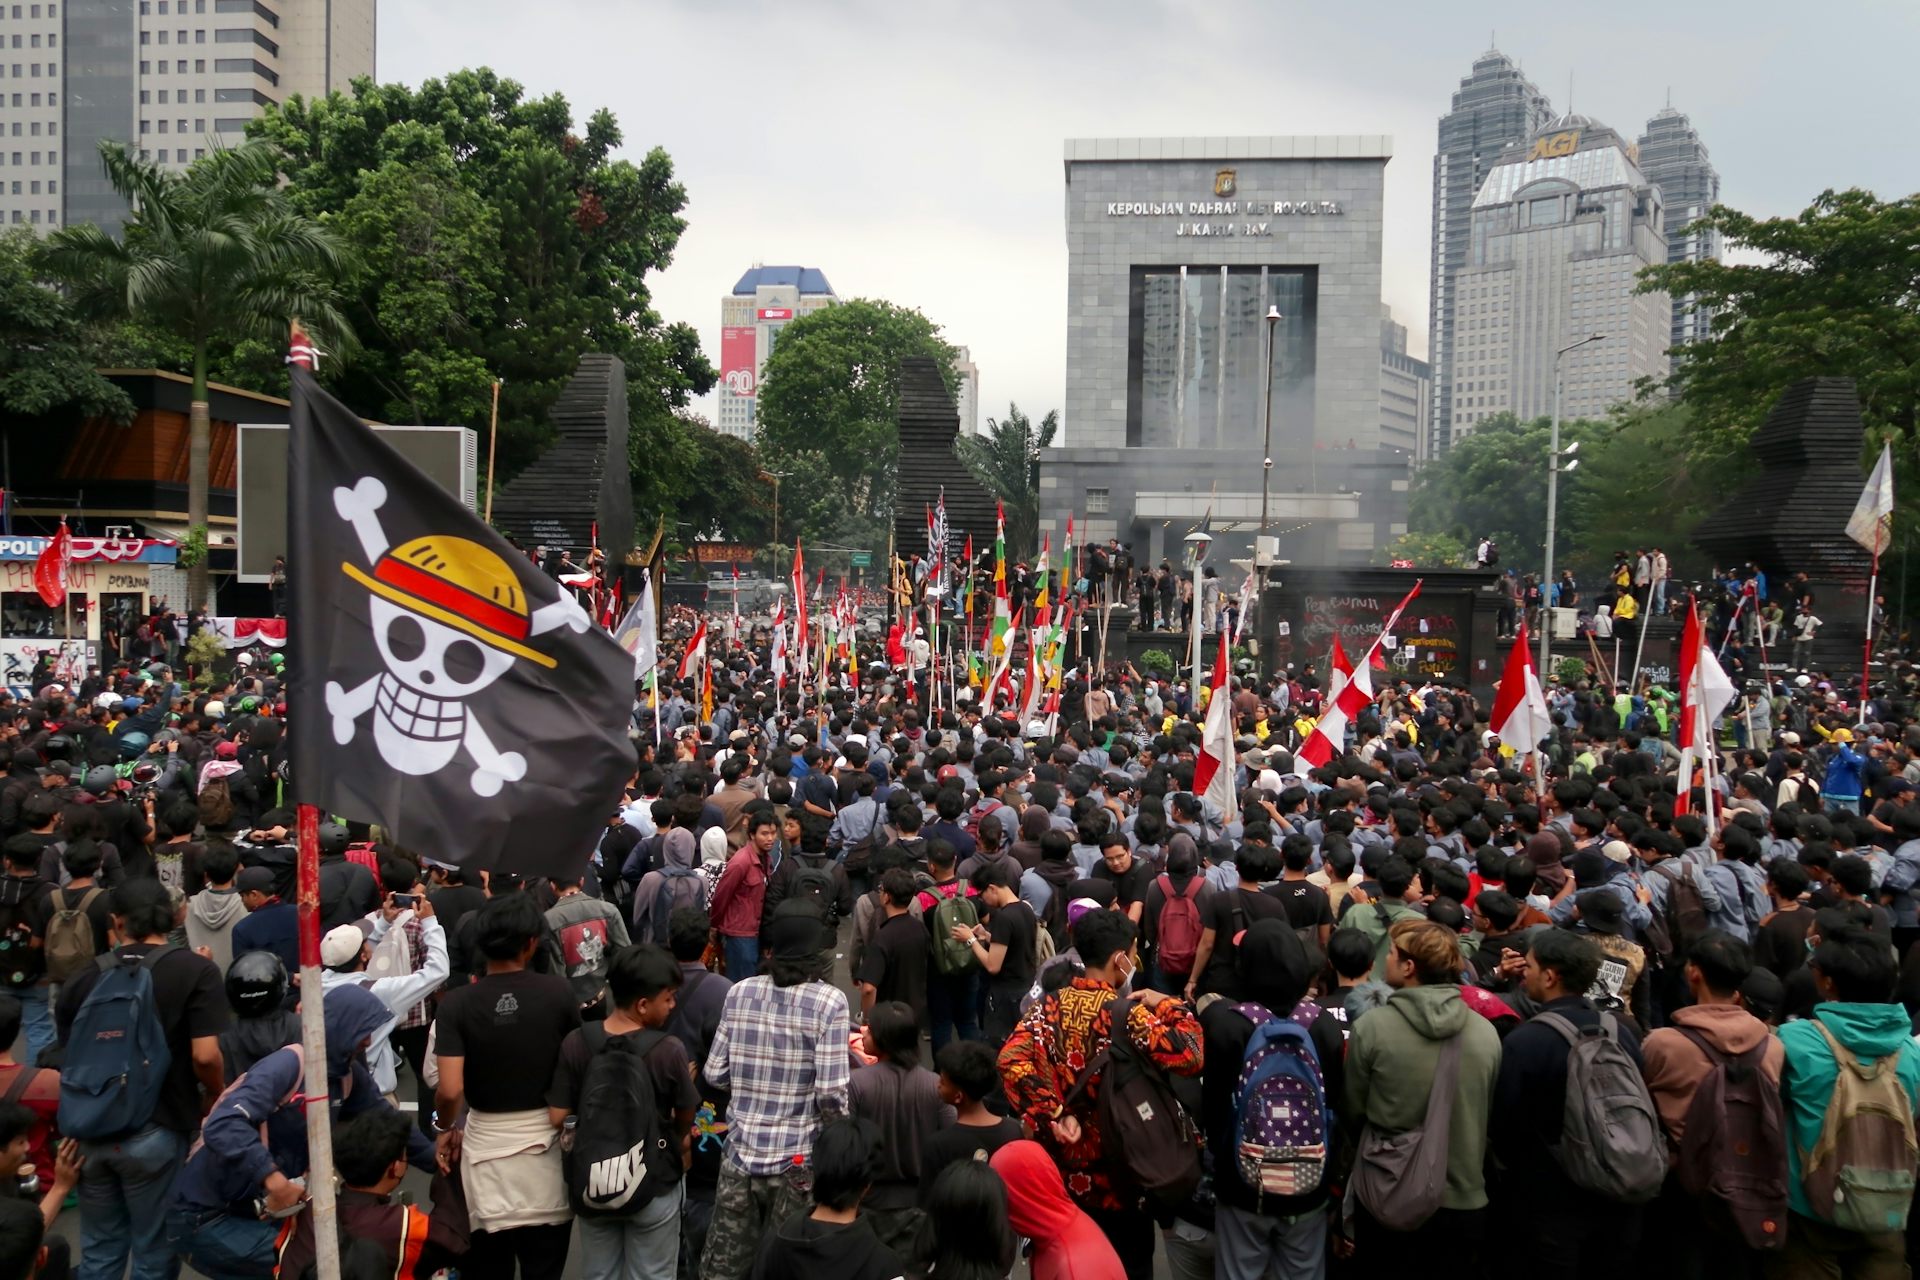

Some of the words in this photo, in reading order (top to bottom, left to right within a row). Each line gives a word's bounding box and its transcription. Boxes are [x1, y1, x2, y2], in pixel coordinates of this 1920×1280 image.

[1526, 131, 1579, 161] AGI
[1107, 202, 1184, 216] KEPOLISIAN
[1189, 202, 1240, 216] DAERAH
[589, 1139, 644, 1198] NIKE
